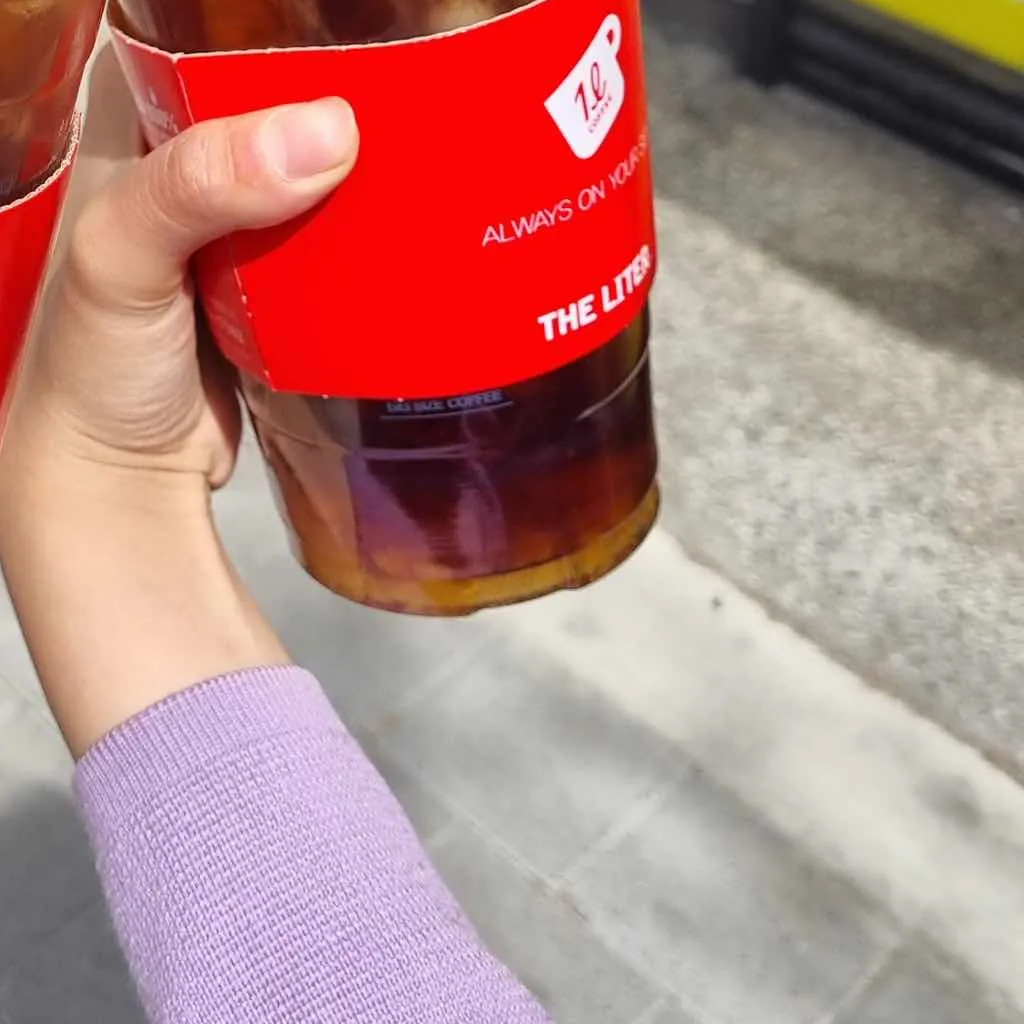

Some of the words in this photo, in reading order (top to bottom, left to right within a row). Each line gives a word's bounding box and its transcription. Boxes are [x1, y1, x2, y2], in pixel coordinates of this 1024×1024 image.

[481, 199, 573, 247] ALWAYS
[578, 181, 606, 211] ON
[537, 293, 598, 342] THE
